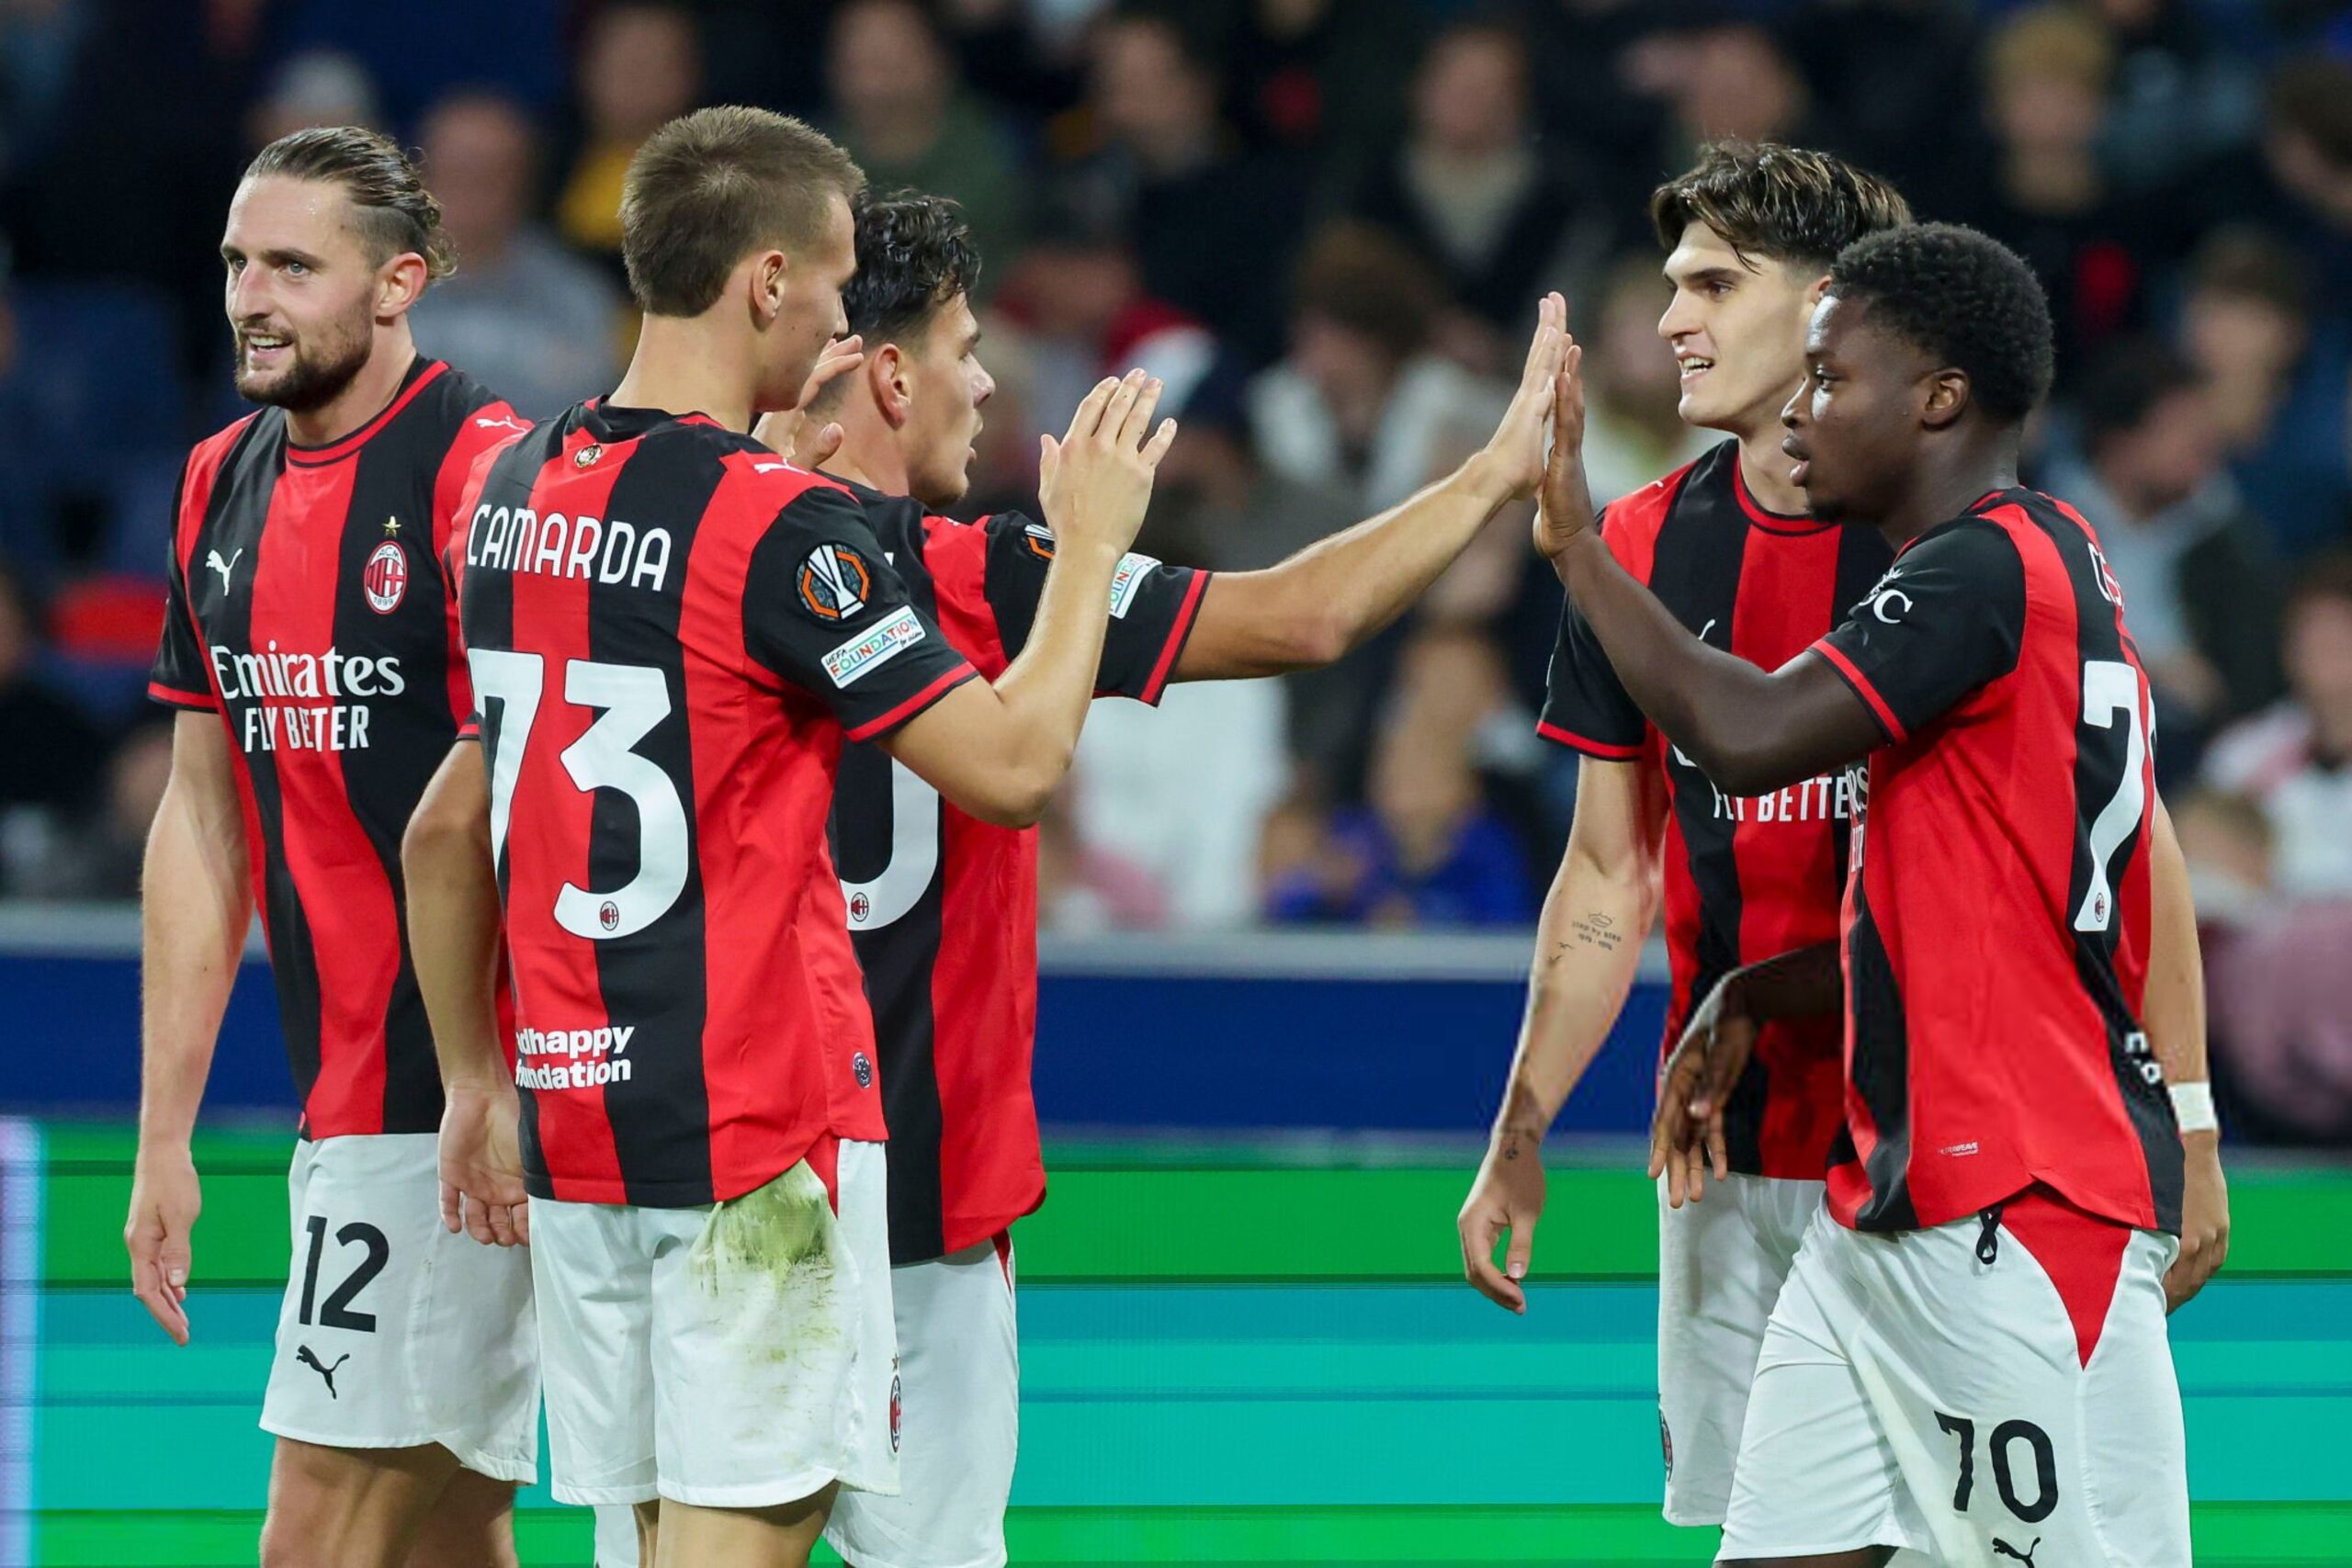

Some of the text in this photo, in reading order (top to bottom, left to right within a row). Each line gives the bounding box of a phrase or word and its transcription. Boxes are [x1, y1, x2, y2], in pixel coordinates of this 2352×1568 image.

[467, 503, 672, 592] CAMARDA
[373, 595, 394, 606] 1899
[210, 640, 405, 700] Emirates
[825, 648, 847, 666] UEFA
[830, 616, 918, 677] FOUNDATION
[244, 705, 278, 753] FLY
[467, 648, 689, 940] 73
[1758, 776, 1849, 823] BETTE
[2074, 660, 2156, 932] 7
[299, 1214, 390, 1333] 12
[1934, 1410, 2059, 1524] 70
